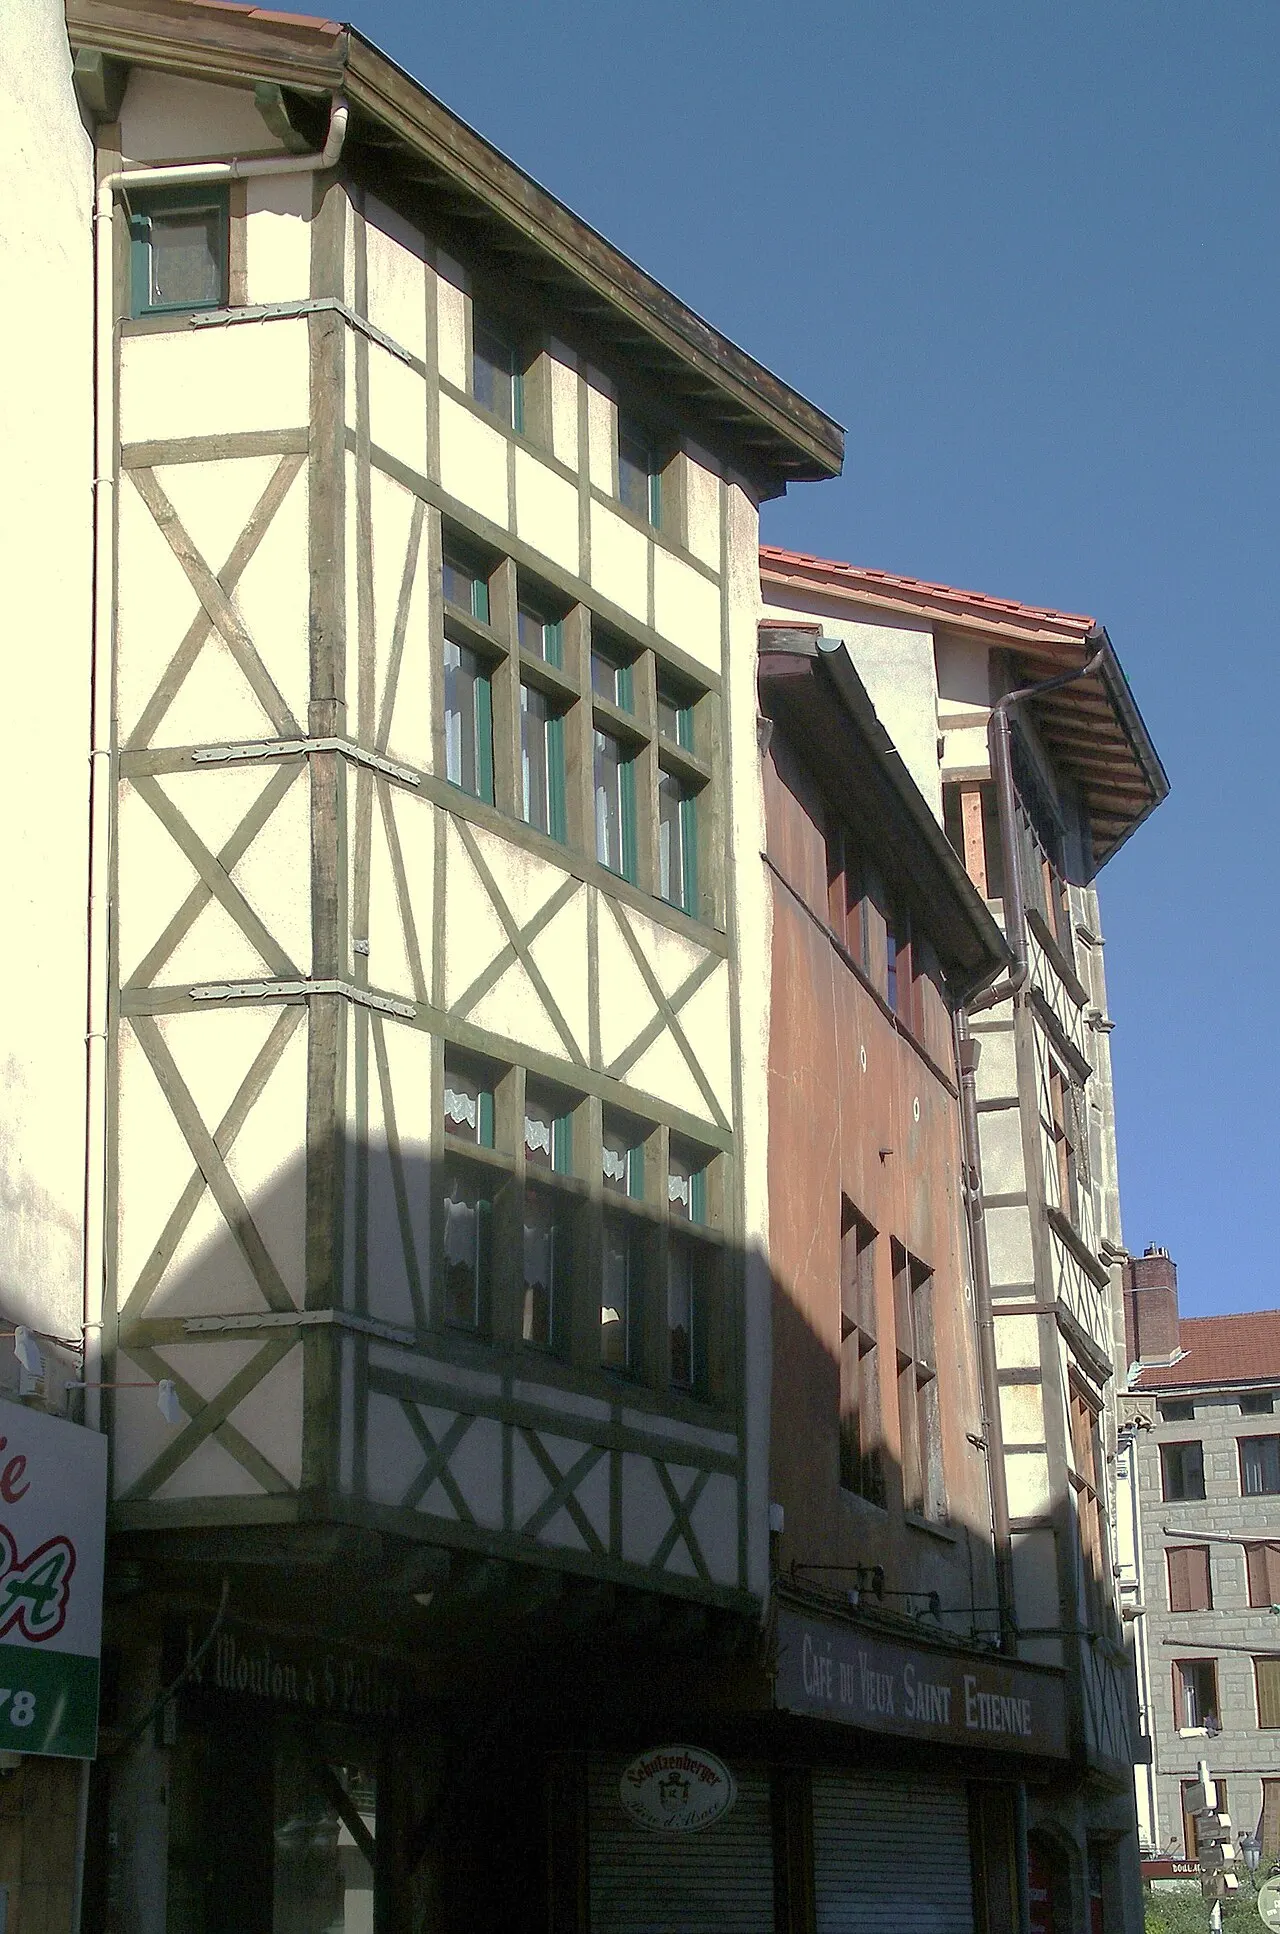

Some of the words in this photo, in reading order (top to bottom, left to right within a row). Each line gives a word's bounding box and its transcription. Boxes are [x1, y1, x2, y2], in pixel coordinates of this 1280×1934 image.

[839, 1662, 855, 1705] DU
[858, 1650, 896, 1716] VIEUX
[903, 1662, 952, 1725] SAINT
[962, 1674, 1033, 1736] ETIENNE
